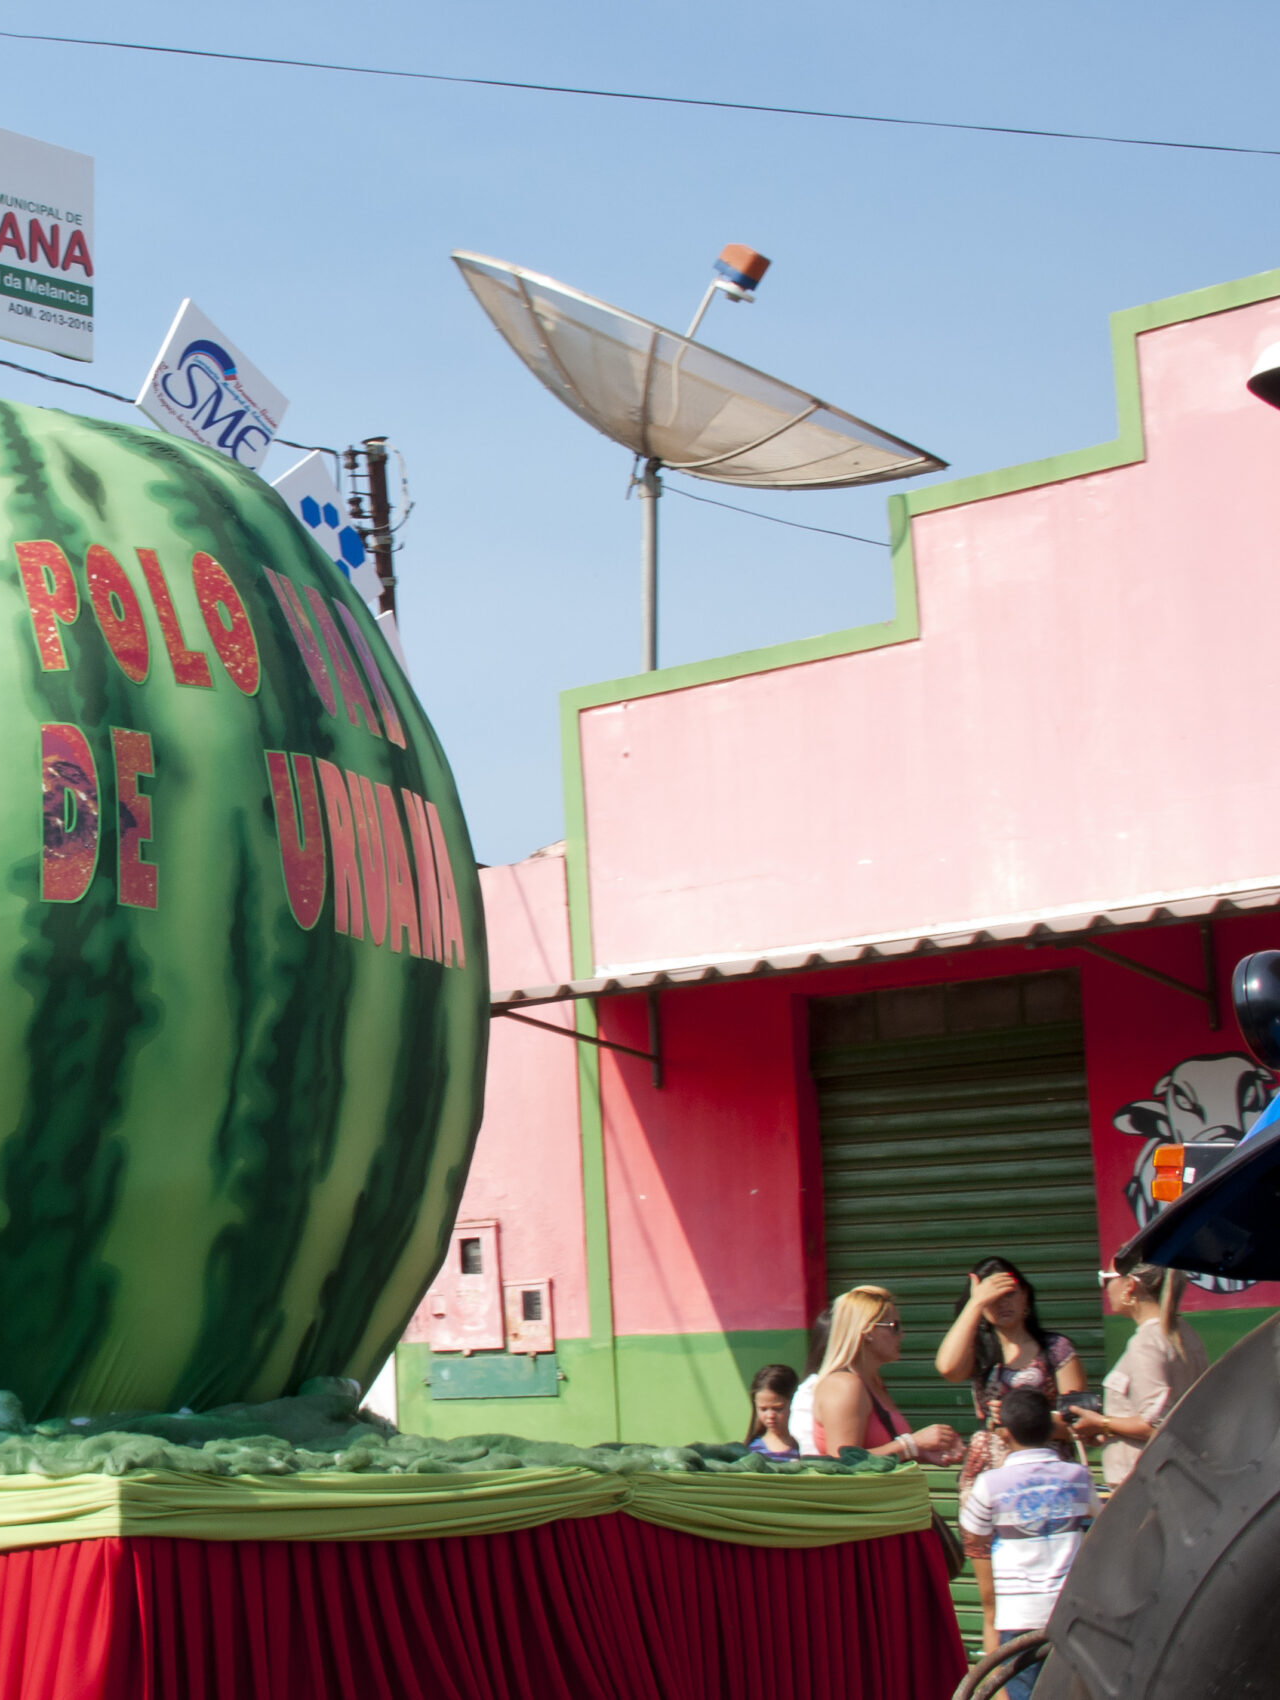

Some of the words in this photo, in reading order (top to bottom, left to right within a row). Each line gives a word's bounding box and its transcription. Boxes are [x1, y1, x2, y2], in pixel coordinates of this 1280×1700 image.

[65, 211, 83, 226] DE
[3, 272, 22, 289] da
[24, 277, 89, 306] Melancia
[8, 302, 36, 319] ADM.
[39, 309, 94, 333] 2013-2016
[161, 363, 270, 470] SME
[13, 539, 261, 697] POLO
[39, 721, 158, 911] DE
[263, 748, 466, 970] URUANA
